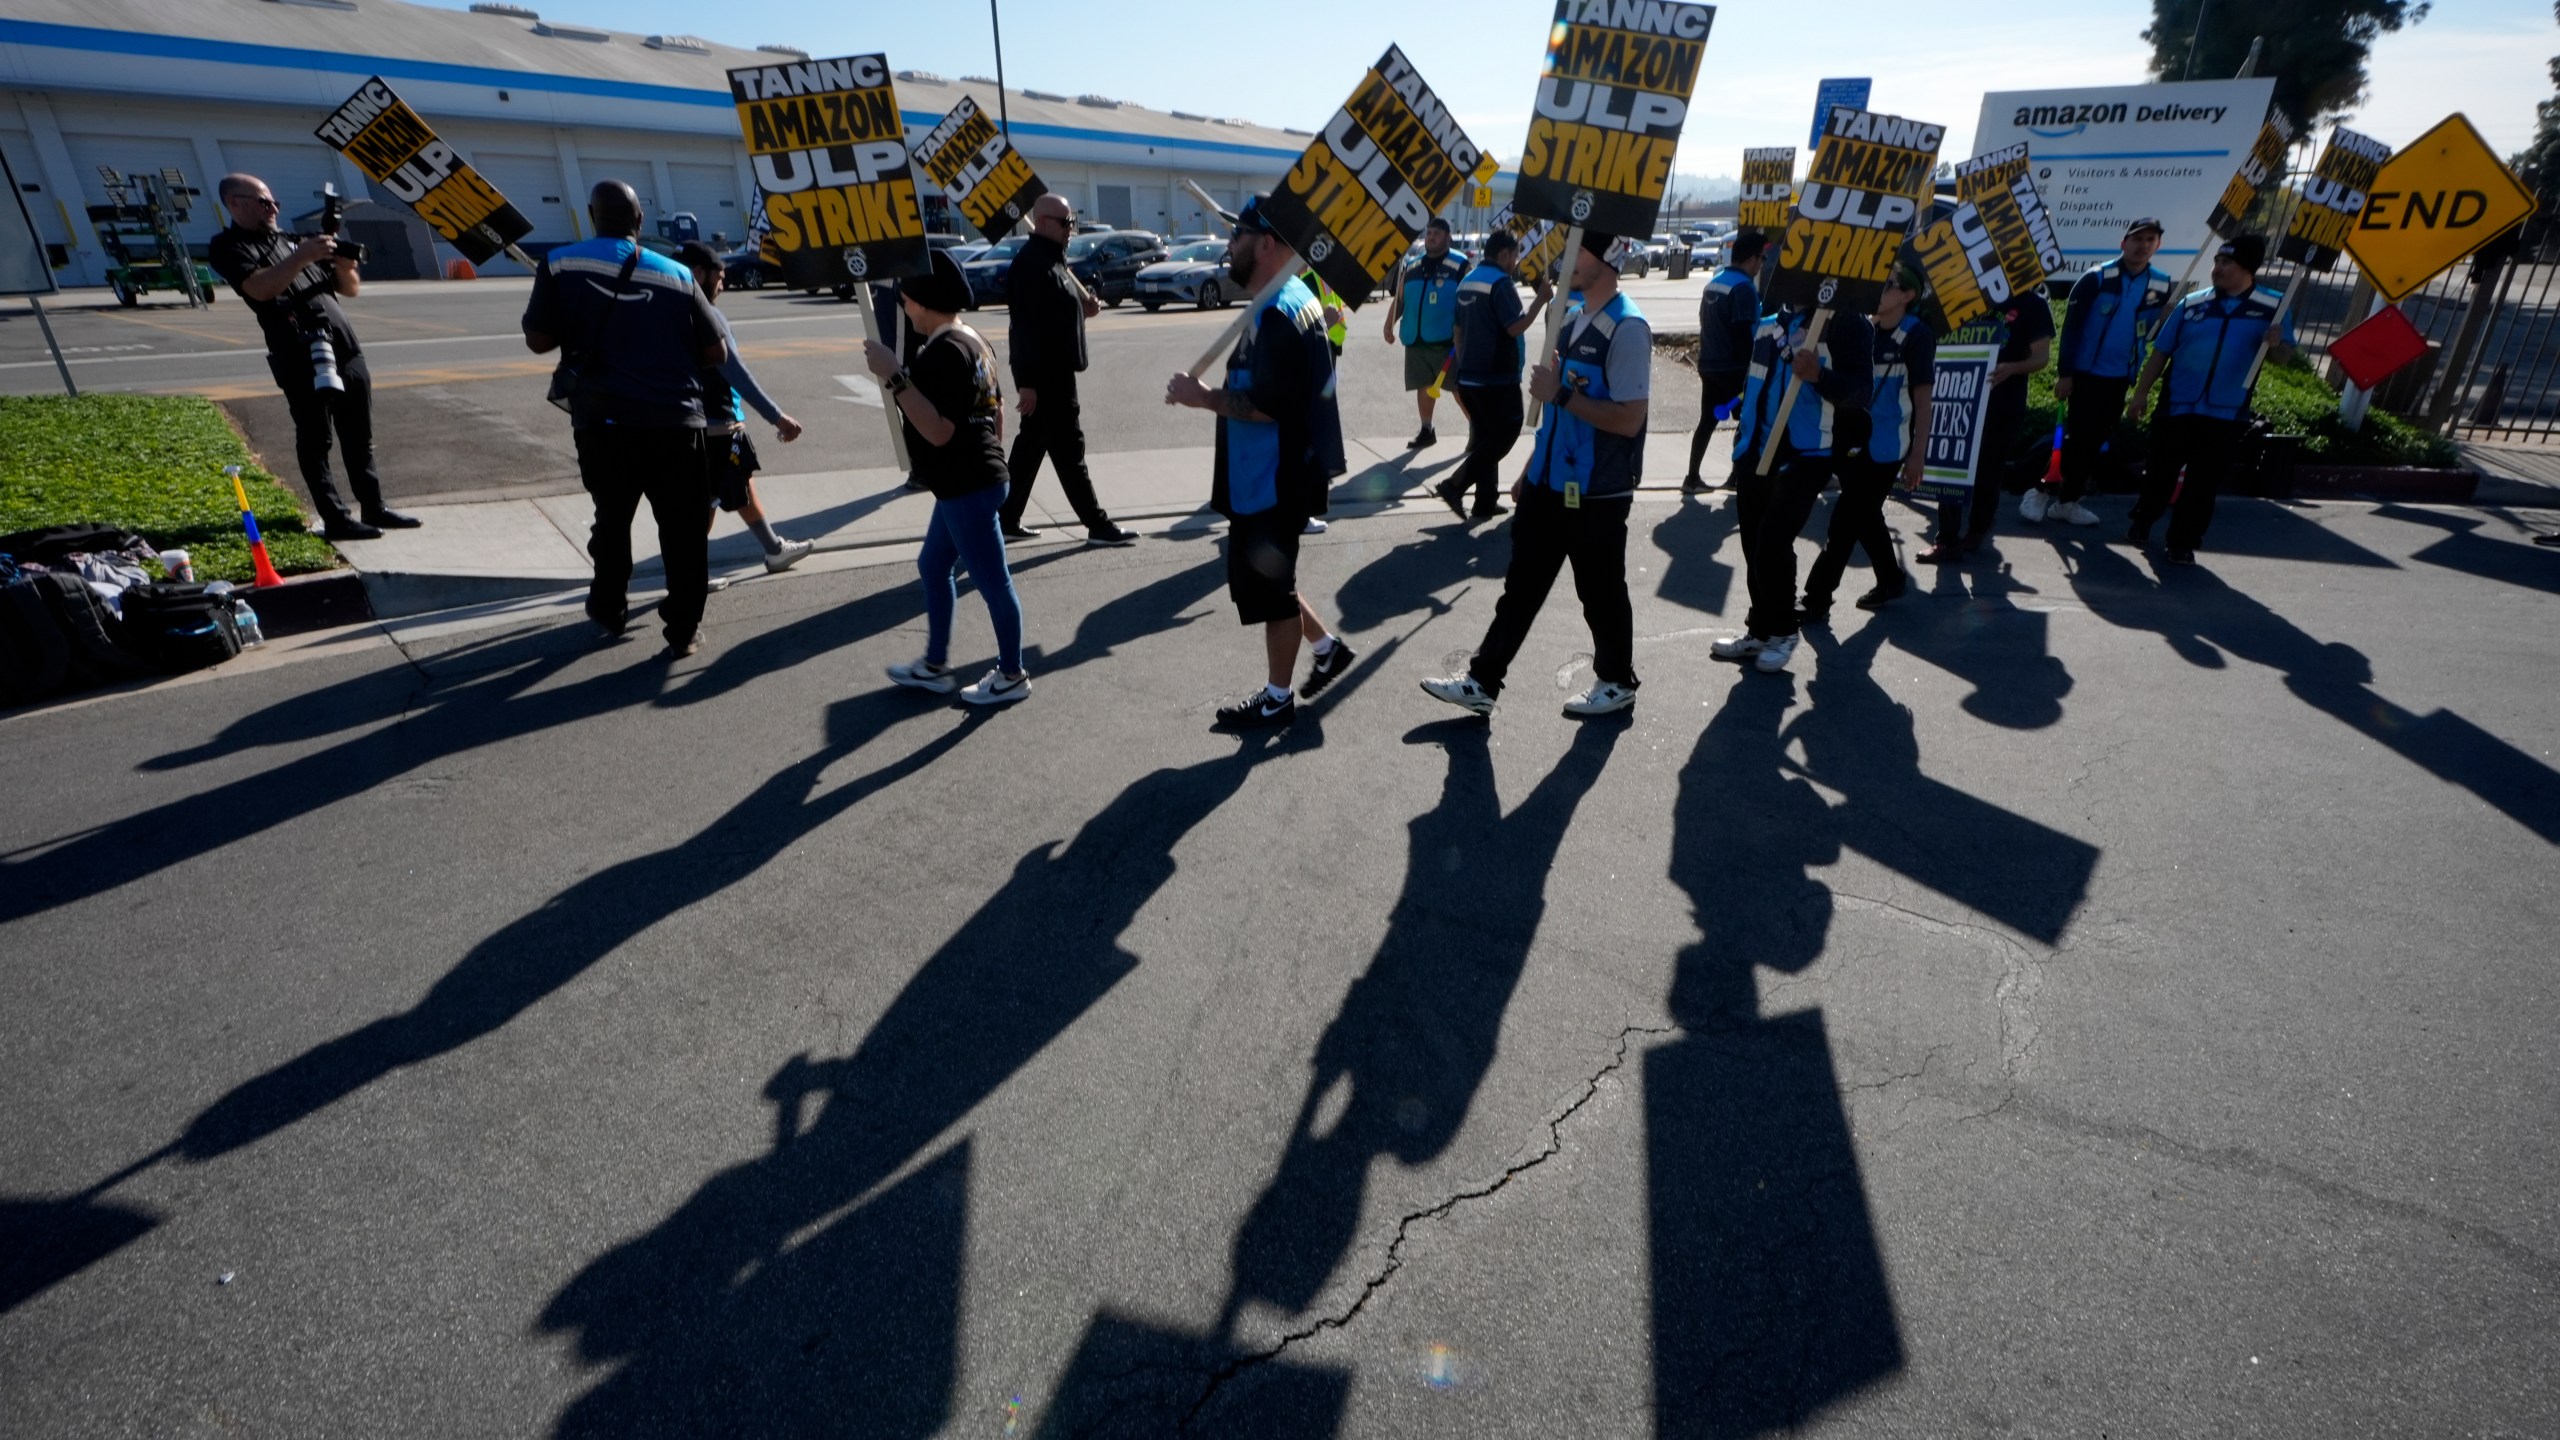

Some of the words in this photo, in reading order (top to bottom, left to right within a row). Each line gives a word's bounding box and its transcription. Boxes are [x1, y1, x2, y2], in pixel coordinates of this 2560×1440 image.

[1565, 0, 1707, 39] TANNC
[733, 56, 884, 100] TANNC
[1553, 27, 1699, 93] AMAZON
[319, 82, 391, 145] TANNC
[750, 90, 896, 150] AMAZON
[914, 100, 974, 163] TANNC
[1383, 48, 1477, 172] TANNC
[1536, 78, 1686, 134] ULP
[1834, 109, 1940, 152] TANNC
[2014, 103, 2128, 126] amazon
[2136, 103, 2227, 123] Delivery
[349, 107, 430, 178] AMAZON
[751, 140, 907, 193] ULP
[928, 114, 995, 184] AMAZON
[944, 134, 1006, 202] ULP
[1325, 106, 1430, 231] ULP
[1351, 80, 1460, 209] AMAZON
[1523, 118, 1677, 200] STRIKE
[1745, 148, 1794, 161] TANNC
[1814, 140, 1931, 196] AMAZON
[1957, 143, 2027, 177] TANNC
[2335, 128, 2388, 164] TANNC
[381, 140, 453, 202] ULP
[960, 150, 1034, 228] STRIKE
[1479, 189, 1486, 200] 5
[1741, 184, 1792, 201] ULP
[1744, 162, 1792, 183] AMAZON
[2064, 185, 2089, 195] Flex
[2068, 167, 2115, 178] Visitors
[2120, 167, 2128, 177] &
[2133, 167, 2202, 178] Associates
[2305, 175, 2368, 214] ULP
[2320, 151, 2381, 191] AMAZON
[415, 165, 505, 239] STRIKE
[766, 179, 923, 251] STRIKE
[1288, 142, 1410, 283] STRIKE
[1739, 201, 1790, 227] STRIKE
[1798, 182, 1915, 229] ULP
[2012, 173, 2062, 272] TANNC
[2056, 218, 2078, 228] Van
[2083, 217, 2130, 230] Parking
[2060, 201, 2113, 212] Dispatch
[2288, 201, 2355, 250] STRIKE
[2359, 190, 2487, 230] END
[1780, 218, 1903, 282] STRIKE
[1952, 202, 2010, 303] ULP
[1978, 191, 2041, 294] AMAZON
[1913, 220, 1987, 330] STRIKE
